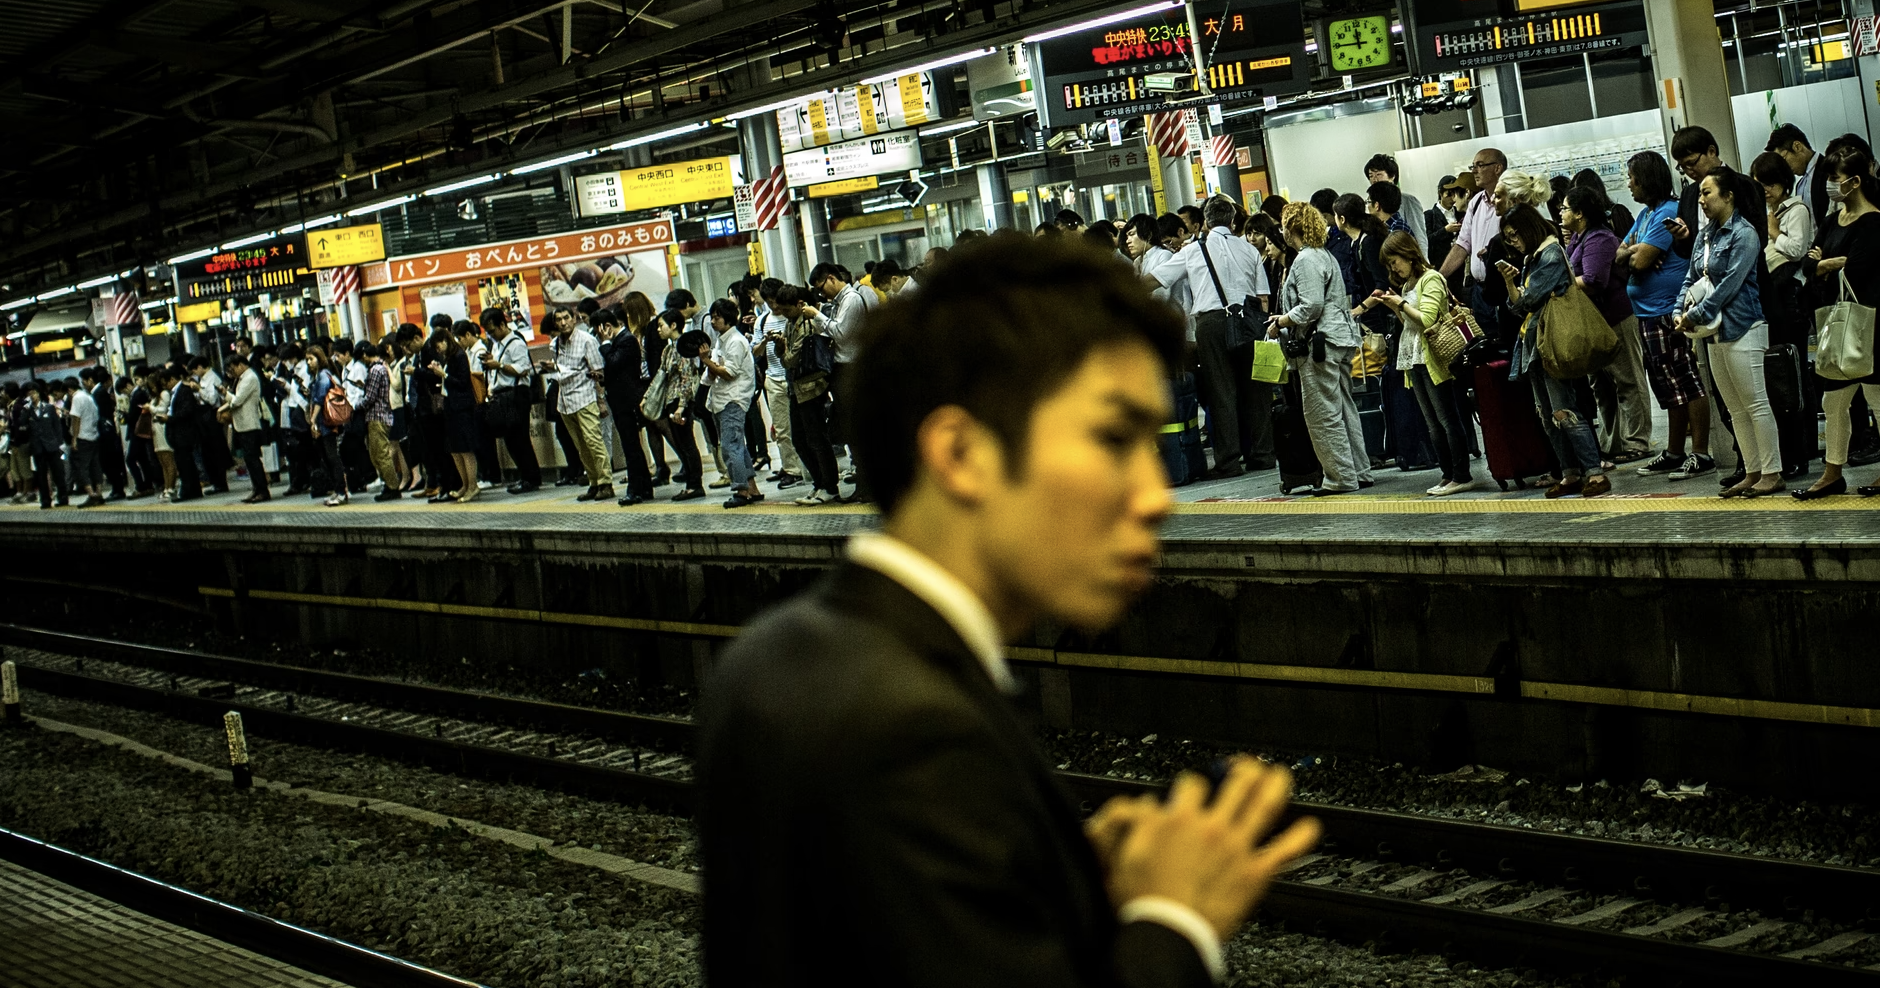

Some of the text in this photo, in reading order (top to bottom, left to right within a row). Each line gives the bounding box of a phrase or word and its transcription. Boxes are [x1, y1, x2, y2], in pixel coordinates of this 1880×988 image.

[1104, 27, 1147, 48] 中央特快
[637, 169, 674, 182] 中央西口
[686, 162, 723, 175] 中央東口
[726, 217, 735, 234] 9
[358, 229, 374, 239] 西口
[397, 257, 440, 280] パン
[466, 240, 560, 270] おべんとう
[580, 224, 669, 253] おのみもの
